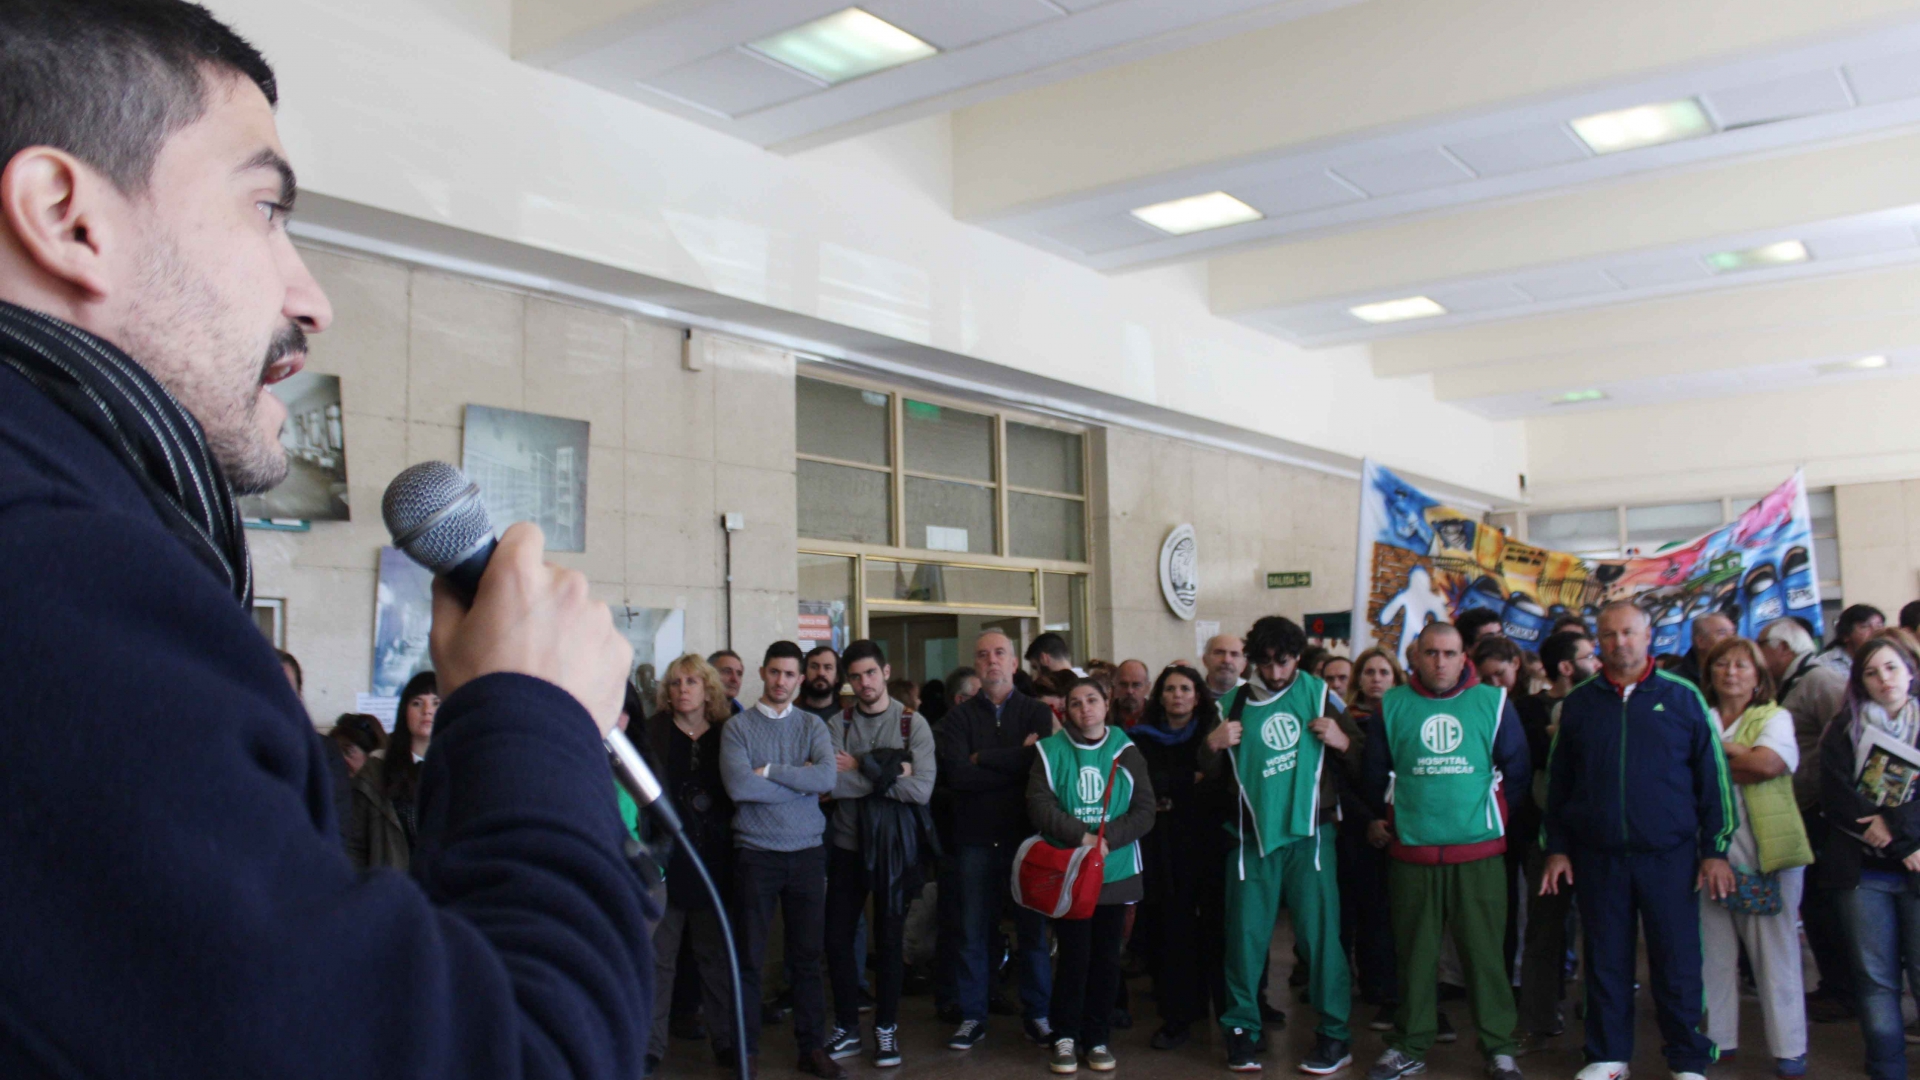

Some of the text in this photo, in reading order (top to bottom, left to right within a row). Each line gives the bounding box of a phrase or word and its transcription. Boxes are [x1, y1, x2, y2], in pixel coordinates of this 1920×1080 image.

[1422, 715, 1462, 753] ATE
[1417, 756, 1469, 767] HOSPITAL
[1262, 767, 1277, 778] DE
